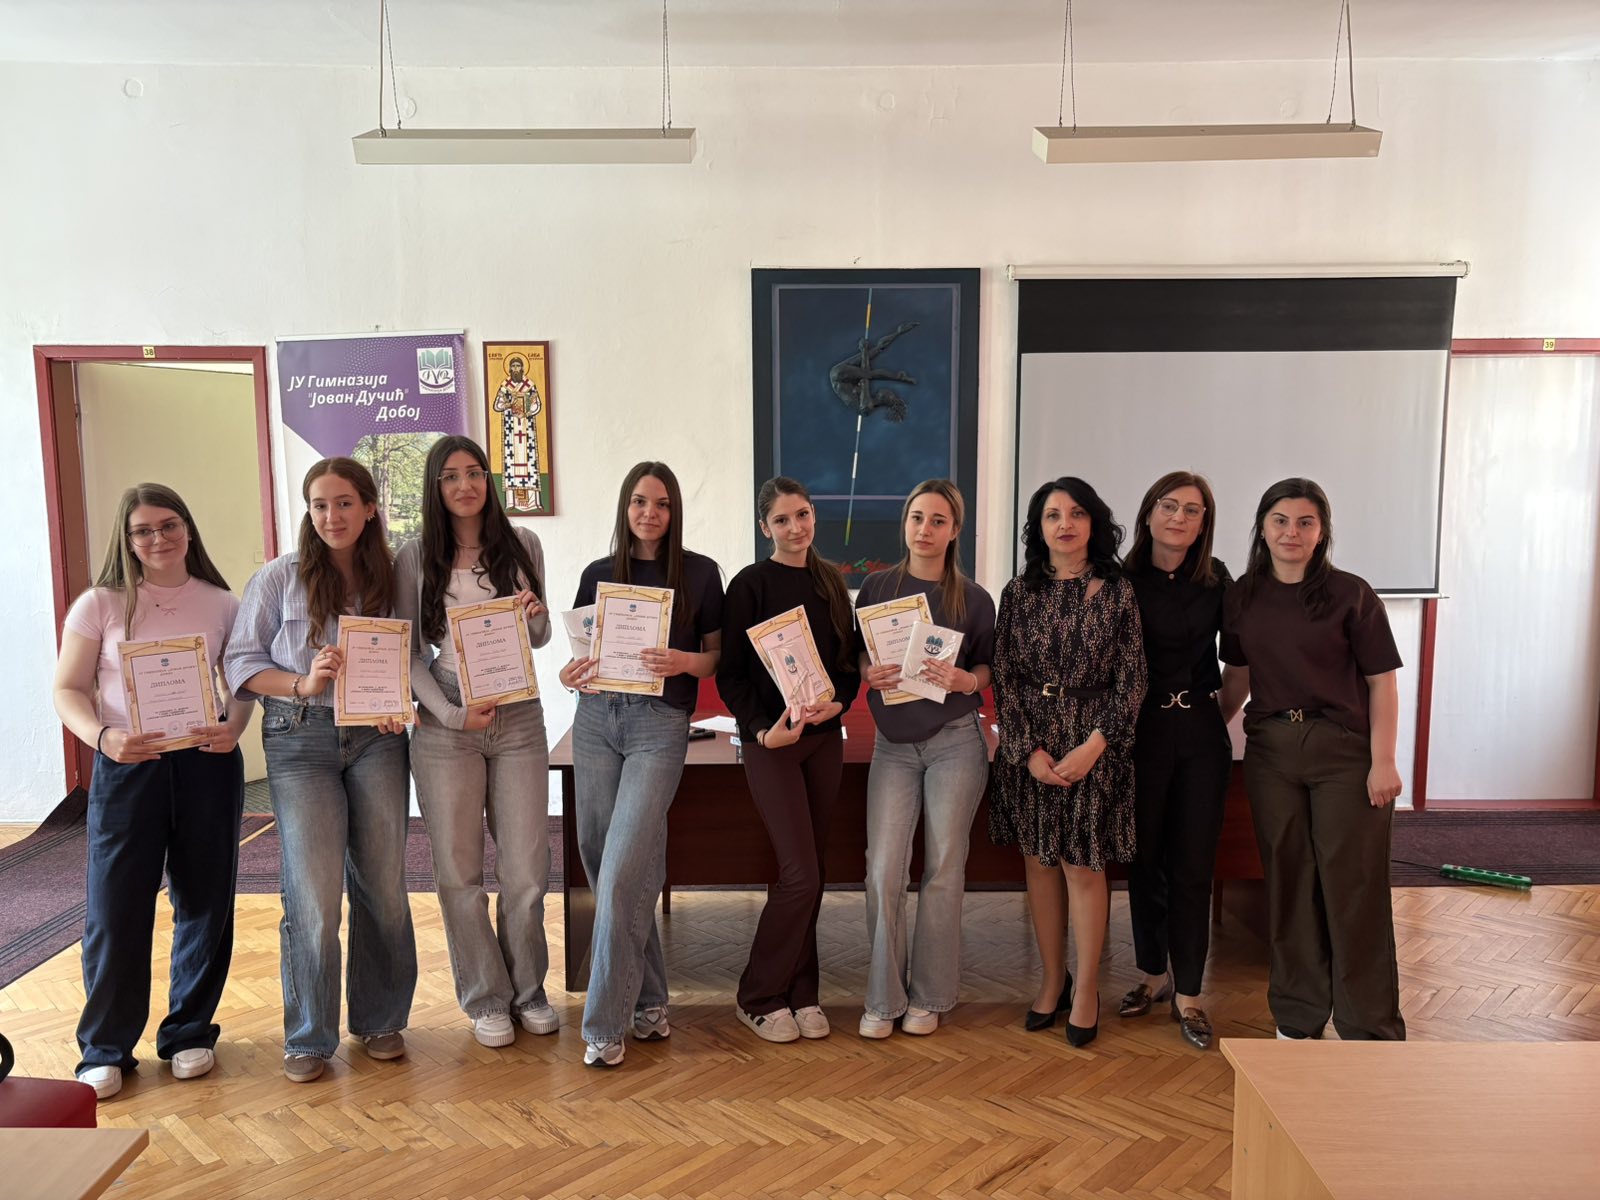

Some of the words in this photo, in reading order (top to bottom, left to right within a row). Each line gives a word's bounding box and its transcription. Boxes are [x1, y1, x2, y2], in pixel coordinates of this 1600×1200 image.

[1545, 341, 1554, 349] 39
[144, 348, 154, 356] 38
[287, 375, 305, 391] ЈУ
[307, 375, 388, 389] Гимназија
[375, 405, 420, 422] Добој
